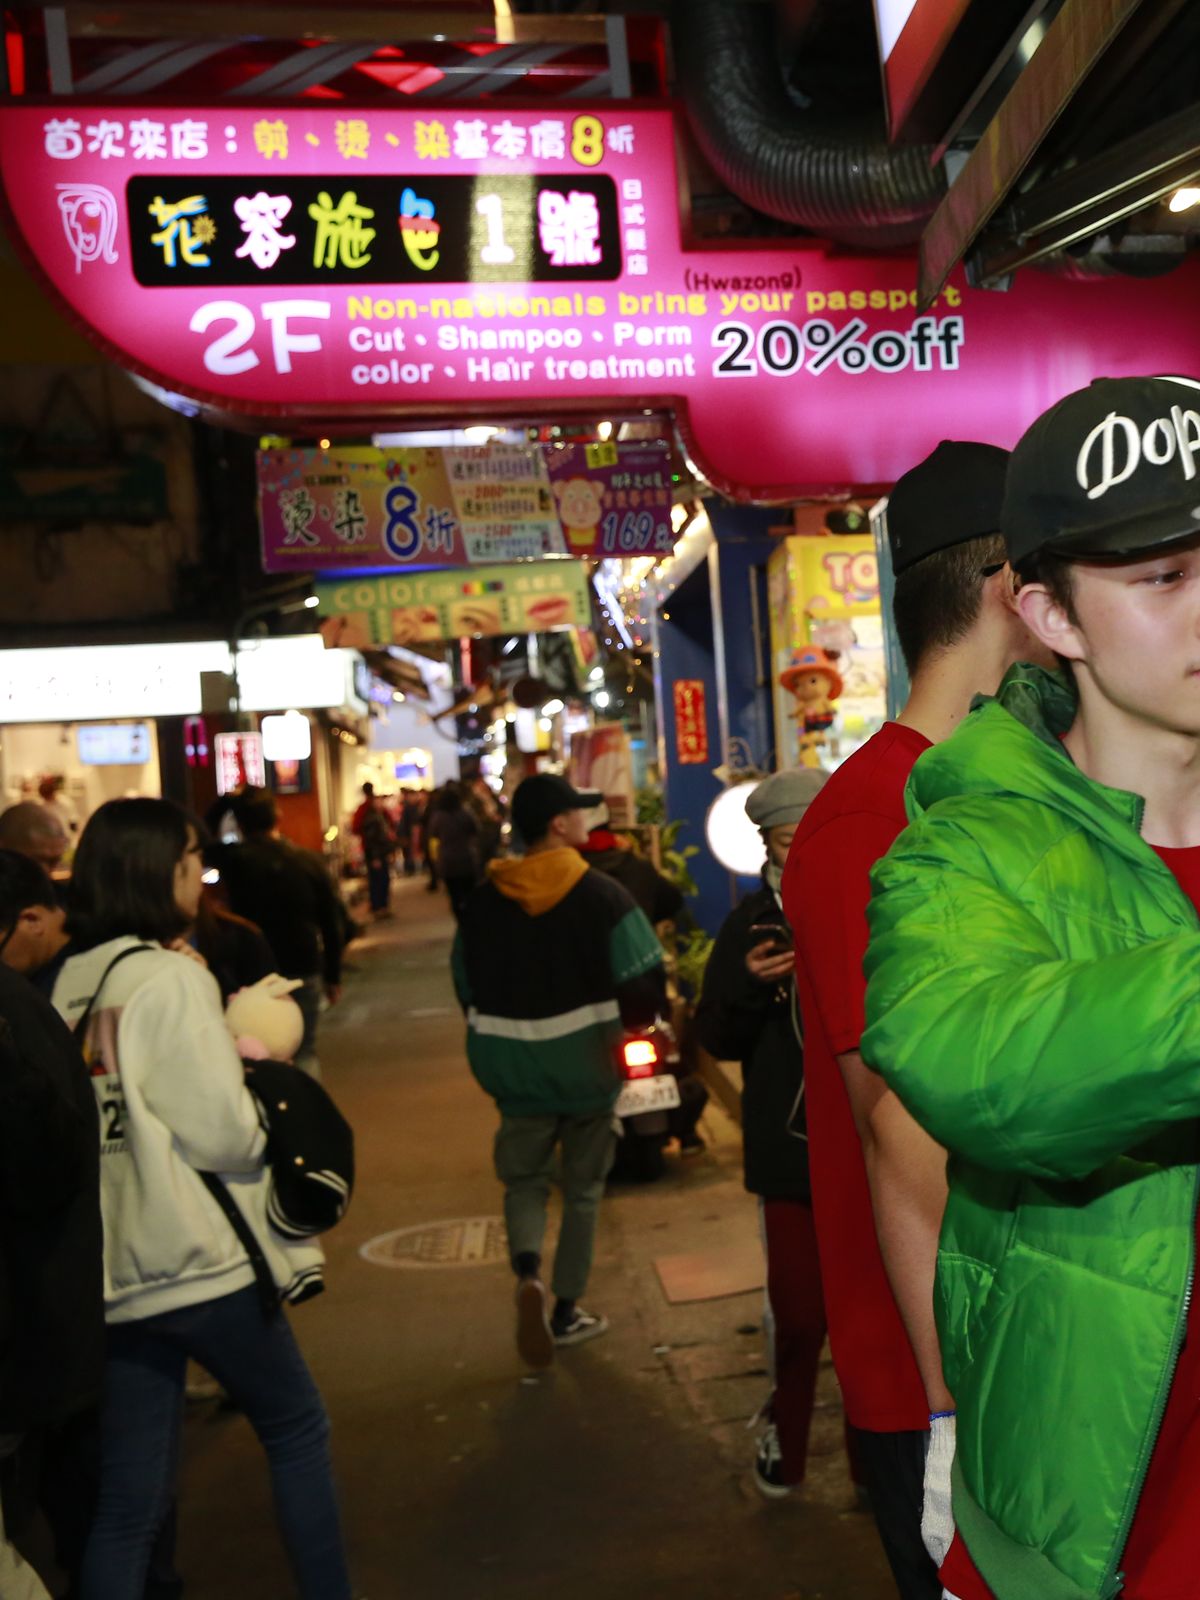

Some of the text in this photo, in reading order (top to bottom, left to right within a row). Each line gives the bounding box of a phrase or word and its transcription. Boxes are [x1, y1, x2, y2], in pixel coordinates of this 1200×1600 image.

[684, 267, 802, 292] (Hwazong)
[346, 284, 962, 320] Non-nationals bring your passpt
[189, 299, 331, 376] 2F
[348, 321, 692, 354] Cut Shampoo Perm
[711, 316, 964, 378] 20%off
[351, 353, 696, 386] color Hair treatment
[334, 580, 429, 610] color
